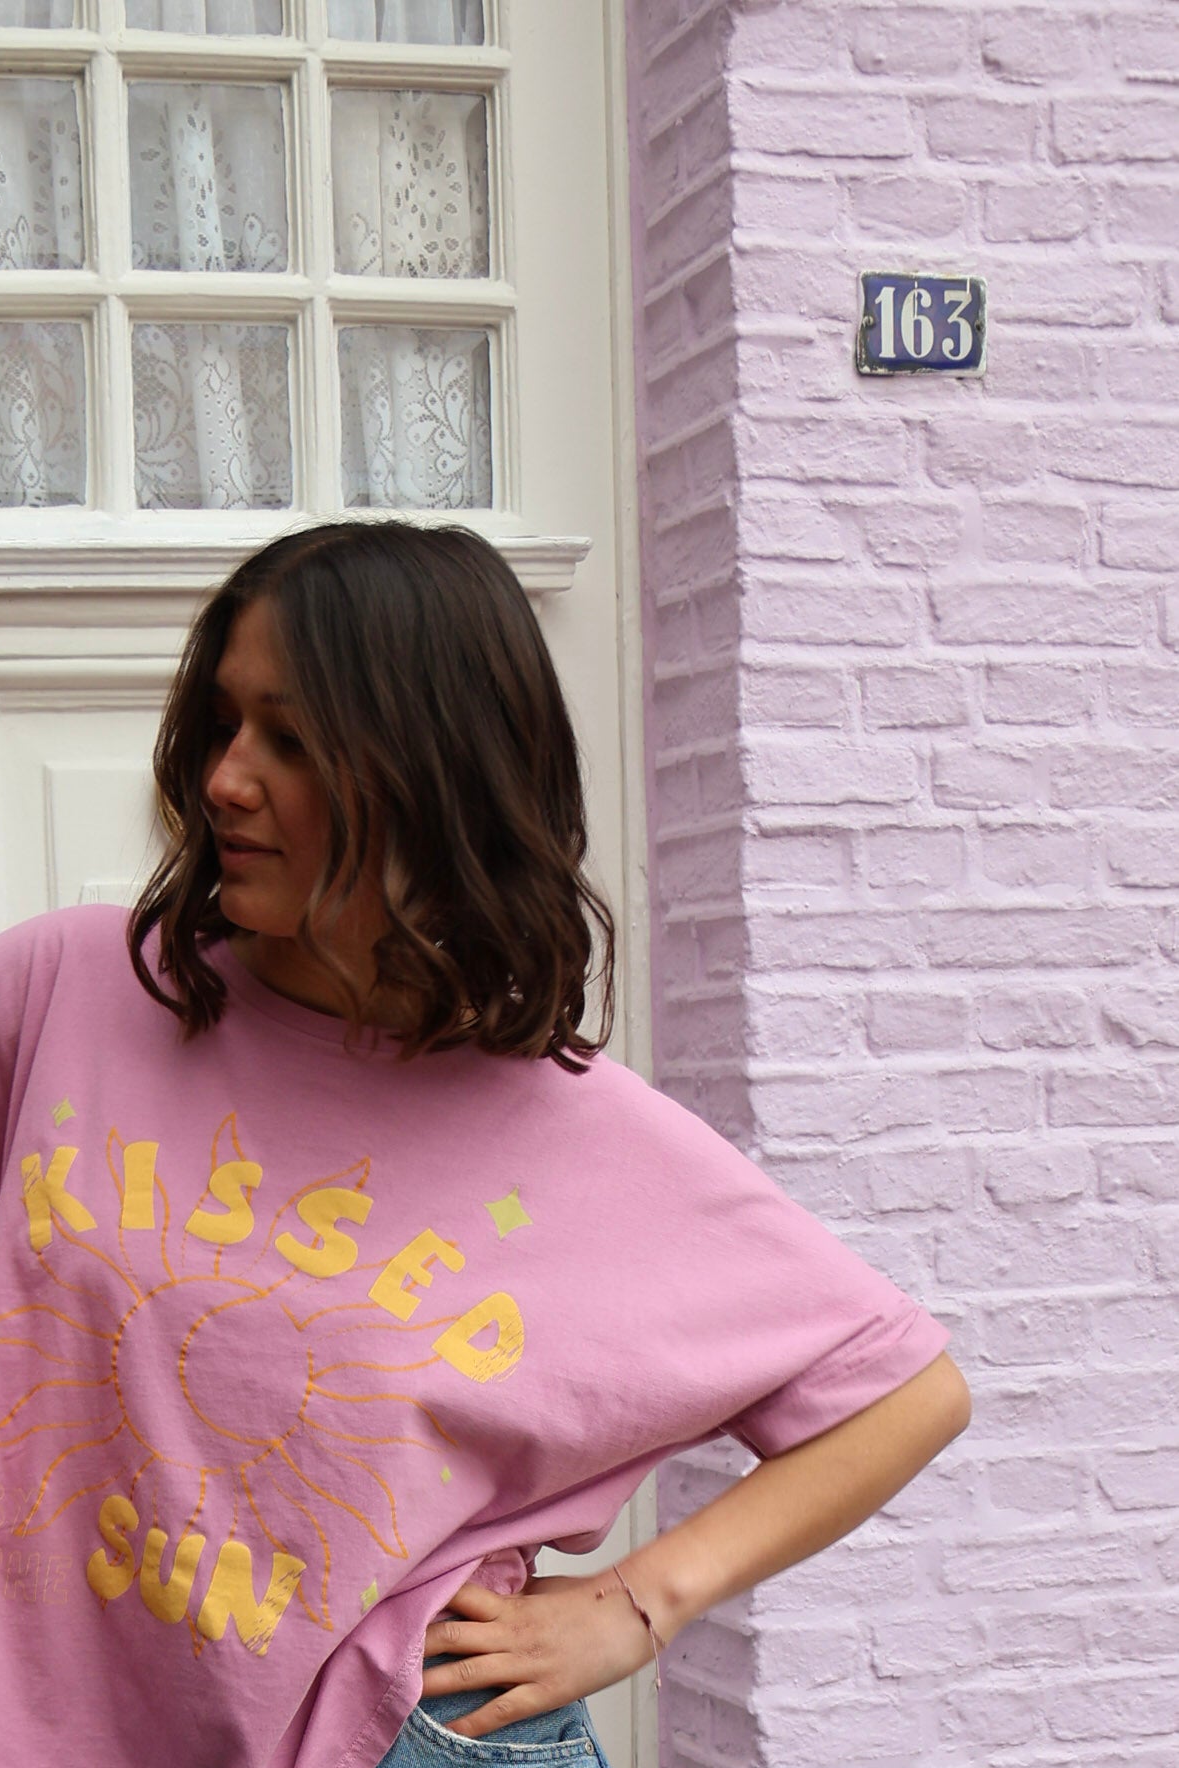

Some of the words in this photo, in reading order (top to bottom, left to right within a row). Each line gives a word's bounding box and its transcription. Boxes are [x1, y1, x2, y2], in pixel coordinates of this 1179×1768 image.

[874, 285, 973, 360] 163
[19, 1140, 525, 1384] KISSED
[87, 1495, 307, 1657] SUN
